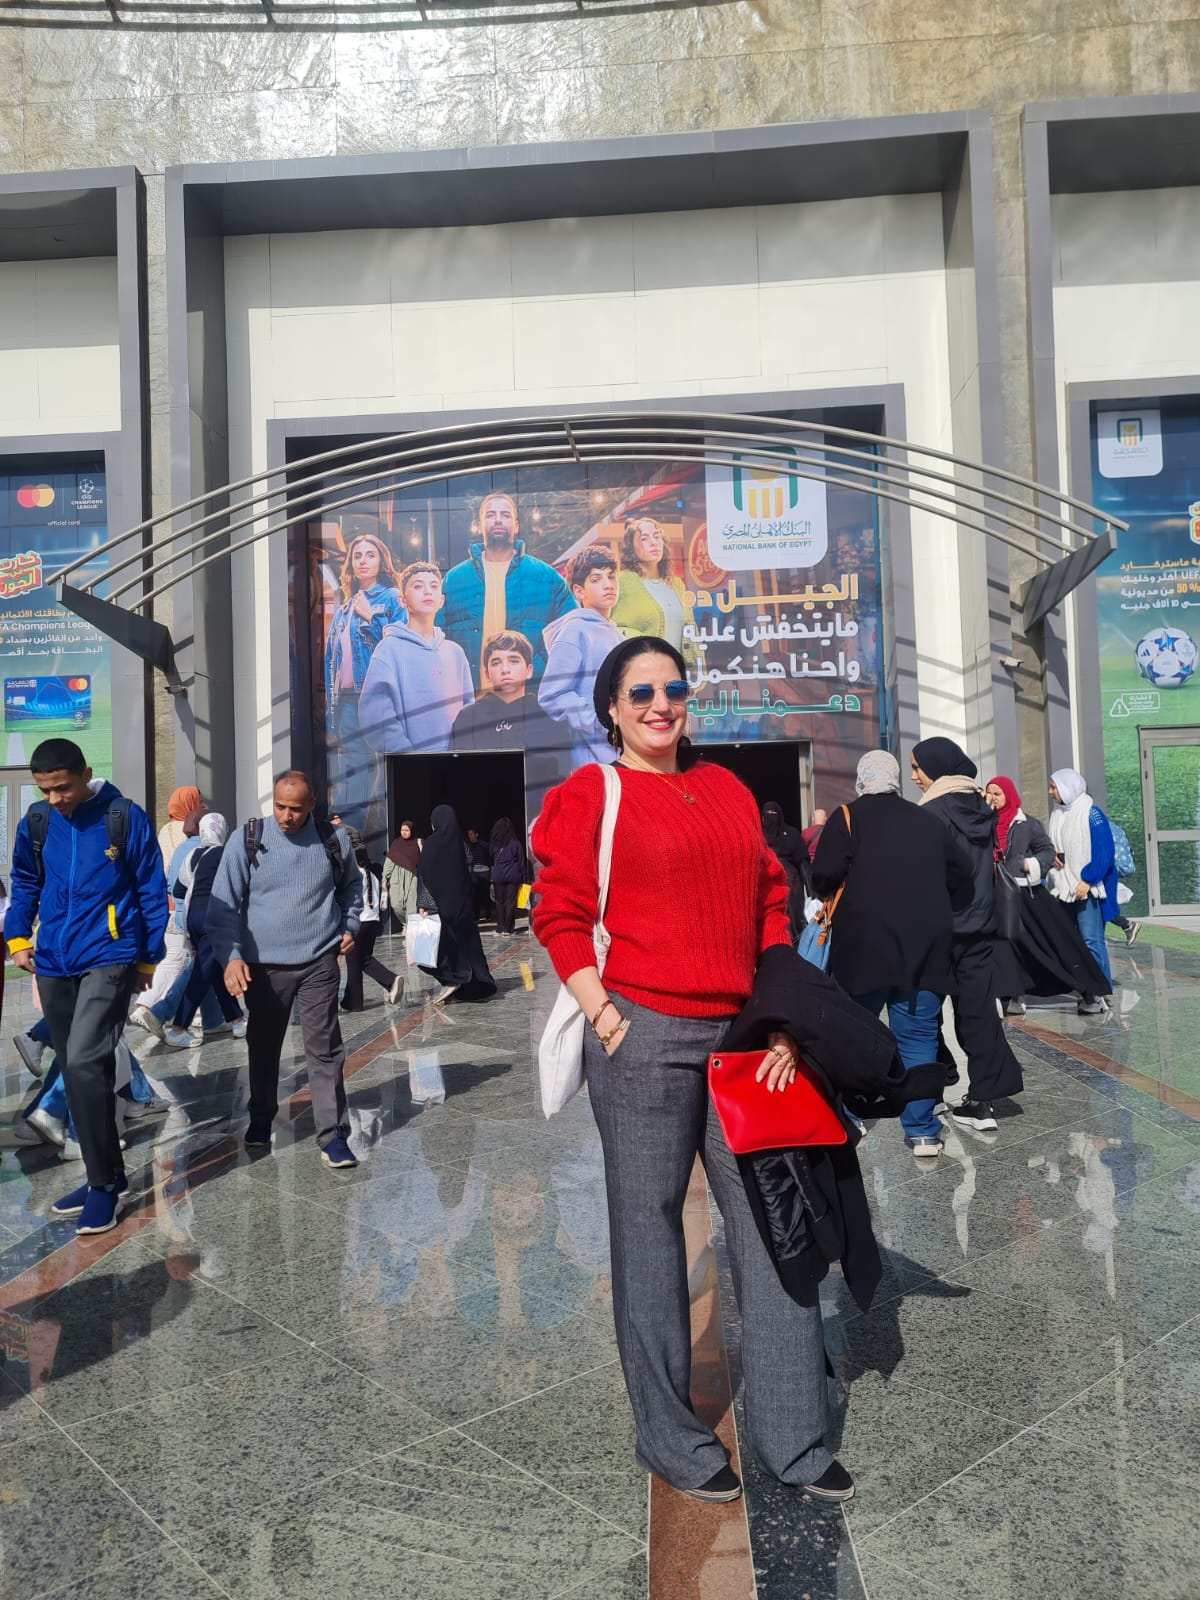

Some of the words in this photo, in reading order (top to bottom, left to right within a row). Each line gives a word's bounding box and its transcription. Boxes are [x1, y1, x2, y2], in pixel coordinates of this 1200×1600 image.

[723, 543, 756, 551] NATIONAL
[789, 540, 812, 548] EGYPT
[1181, 570, 1200, 579] UEF
[717, 573, 859, 613] الجيل
[1160, 587, 1175, 597] من
[1176, 583, 1188, 593] 50
[682, 590, 713, 608] ده
[11, 621, 65, 632] Champions
[67, 620, 94, 630] Leag
[67, 635, 81, 643] من
[82, 633, 103, 642] واحد
[683, 617, 736, 650] عليه
[0, 646, 24, 657] أقص
[26, 649, 50, 657] بحد
[686, 655, 787, 688] هنكمل
[790, 651, 861, 683] واحنا
[687, 690, 727, 725] ليه
[732, 688, 861, 717] دعمنا
